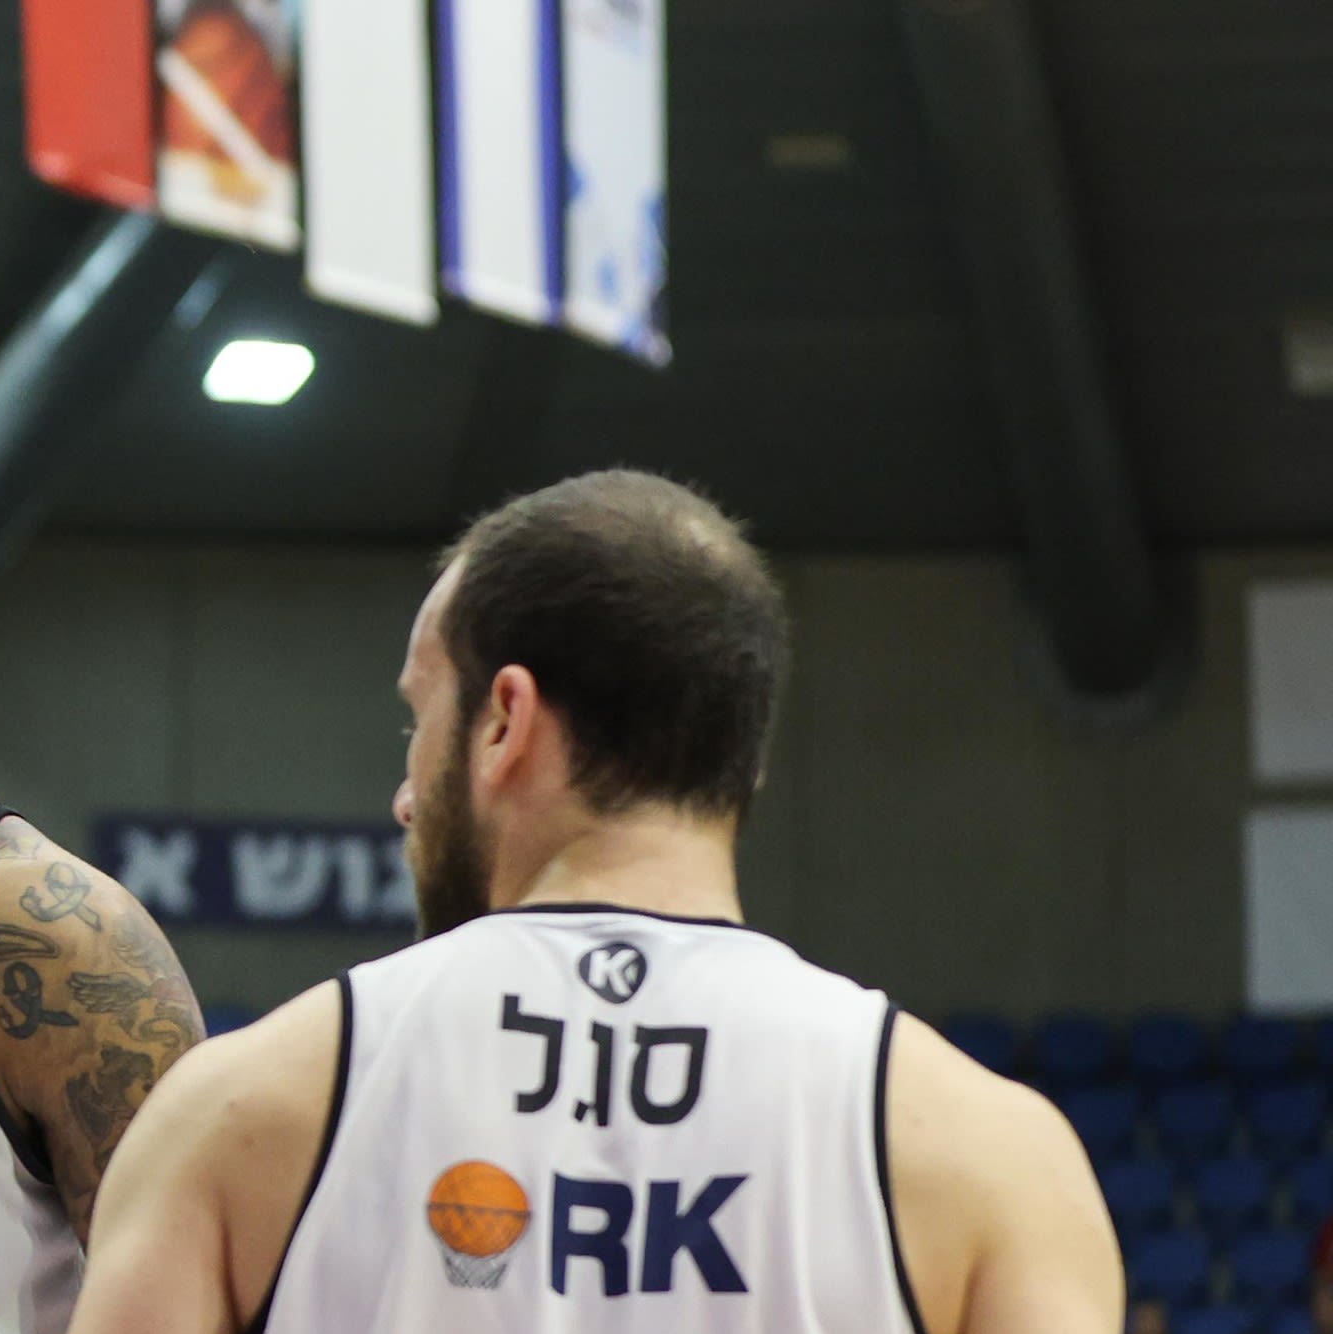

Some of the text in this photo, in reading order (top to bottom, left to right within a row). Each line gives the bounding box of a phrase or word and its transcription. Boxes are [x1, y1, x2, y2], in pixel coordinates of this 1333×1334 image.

[119, 827, 198, 920] א
[501, 993, 709, 1128] סגל
[550, 1171, 750, 1298] RK
